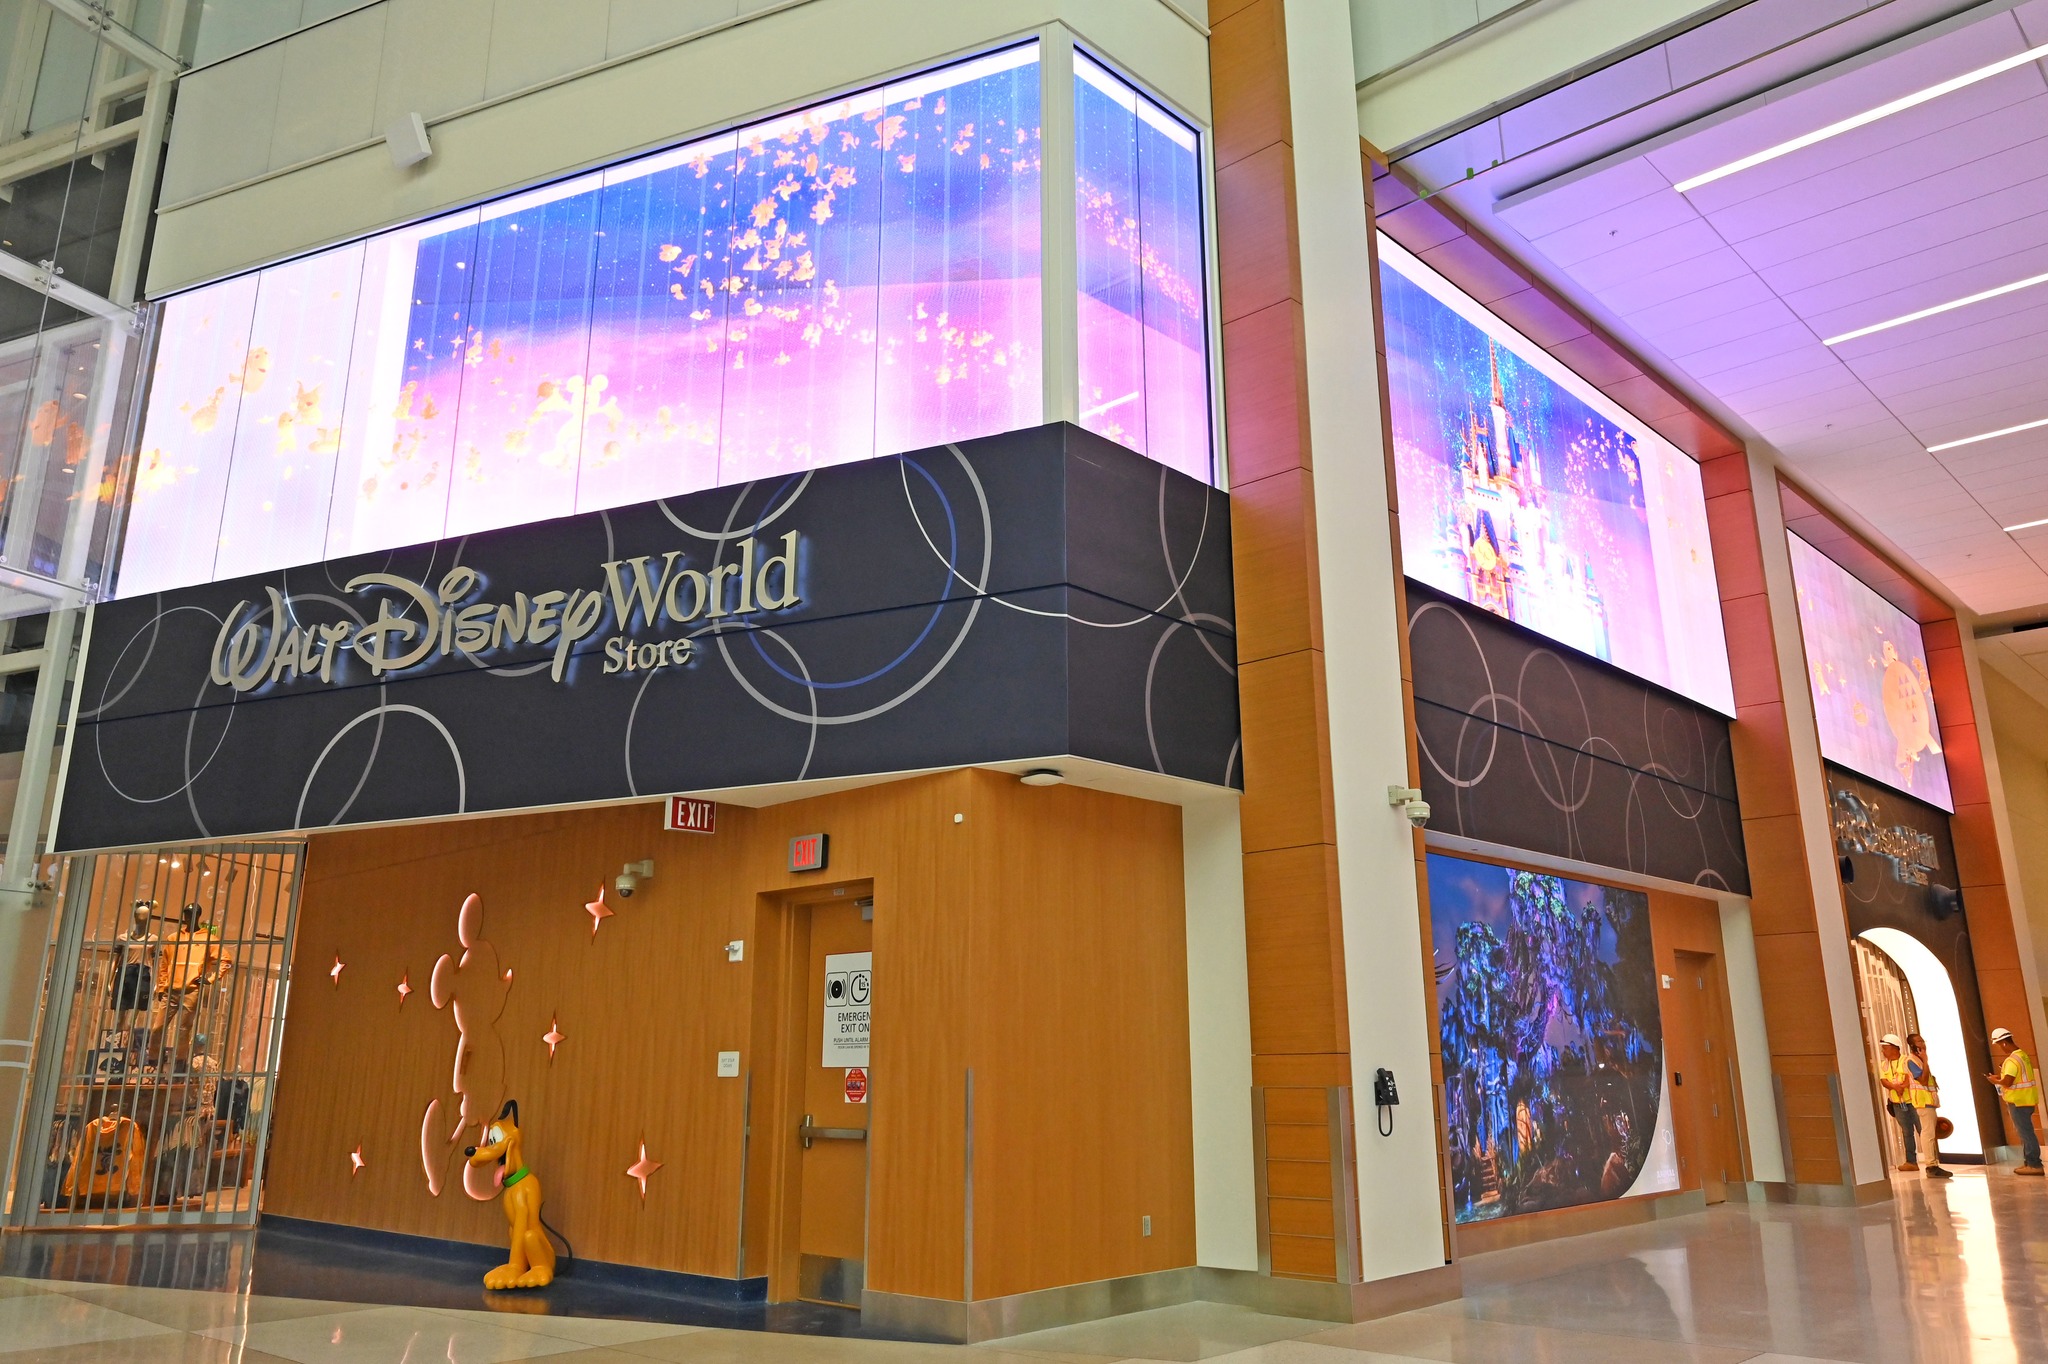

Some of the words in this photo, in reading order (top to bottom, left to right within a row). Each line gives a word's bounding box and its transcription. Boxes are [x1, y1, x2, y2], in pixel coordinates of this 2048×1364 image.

[601, 530, 803, 632] World
[603, 635, 696, 675] Store
[677, 800, 711, 829] EXIT
[793, 838, 818, 867] EXIT
[841, 1023, 857, 1033] EXIT
